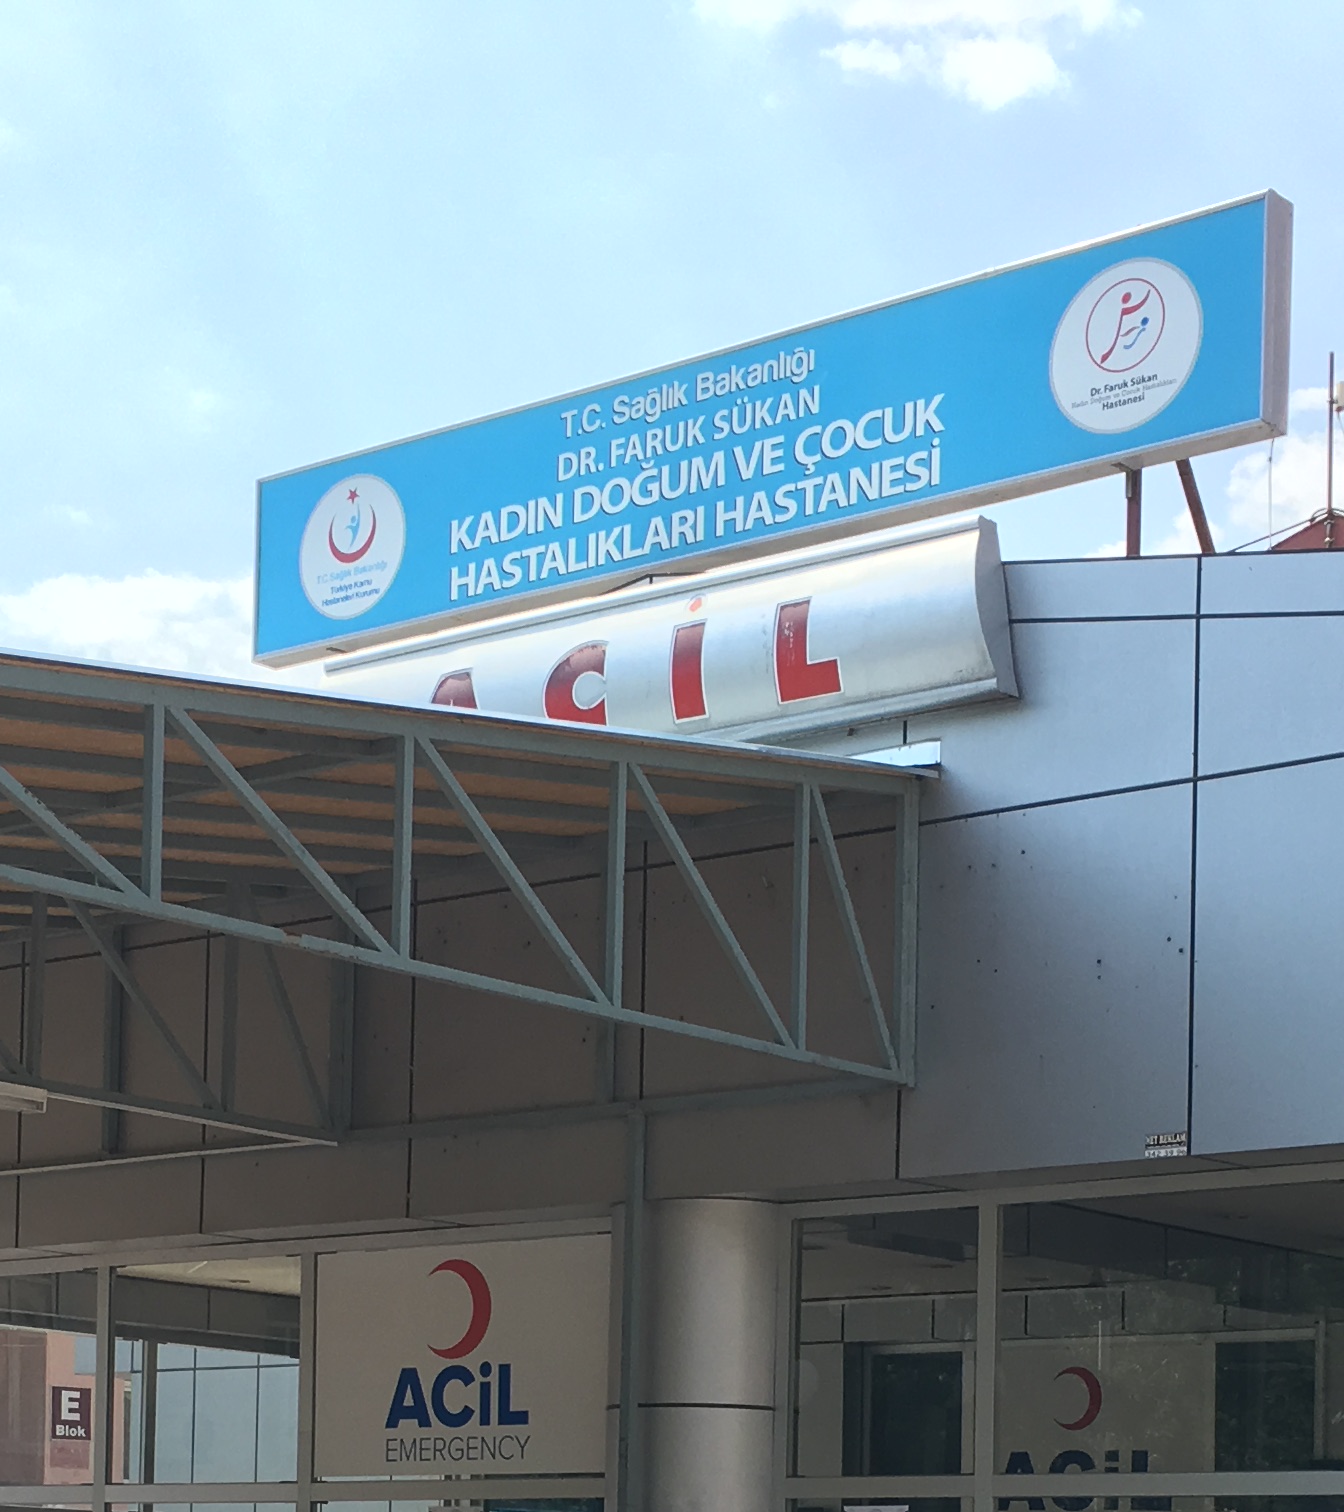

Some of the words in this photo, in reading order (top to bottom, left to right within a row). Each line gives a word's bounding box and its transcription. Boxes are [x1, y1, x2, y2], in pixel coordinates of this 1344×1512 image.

[560, 403, 606, 438] T.C.
[612, 381, 688, 424] Sağlık
[696, 346, 815, 402] Bakanlığı
[1104, 379, 1128, 393] Faruk
[557, 446, 604, 482] DR.
[610, 415, 705, 468] FARUK
[713, 385, 820, 440] SÜKAN
[450, 492, 563, 554] KADIN
[572, 450, 725, 525] DOĞUM
[733, 435, 785, 481] VE
[794, 393, 945, 476] ÇOCUK
[449, 505, 704, 601] HASTALIKLARI
[715, 437, 941, 537] HASTANESİ
[56, 1424, 86, 1437] Blok
[61, 1390, 80, 1421] E
[385, 1435, 531, 1462] EMERGENCY
